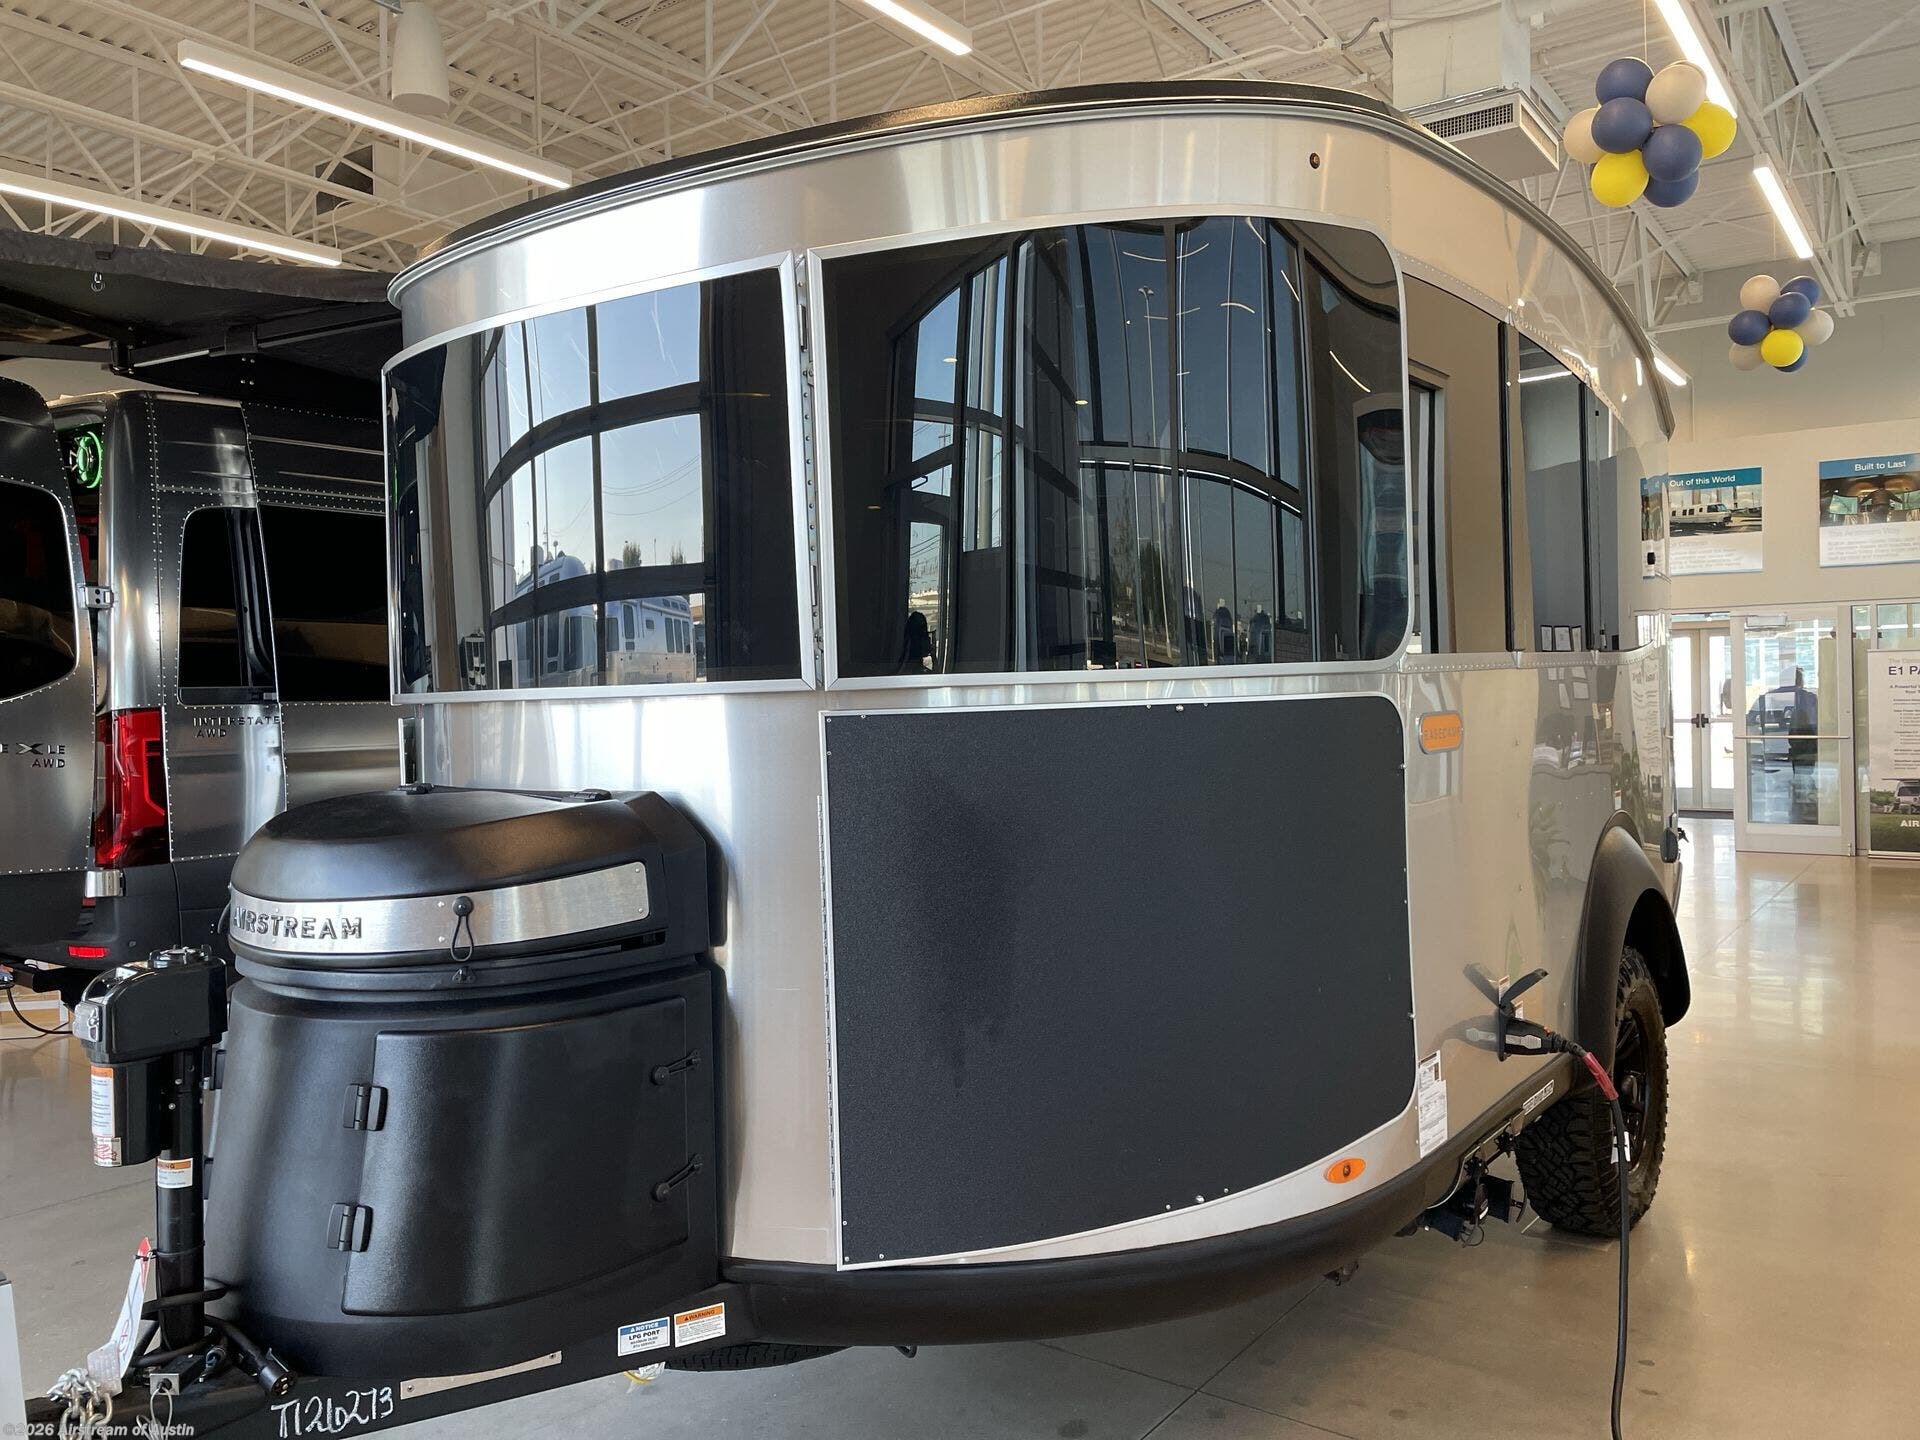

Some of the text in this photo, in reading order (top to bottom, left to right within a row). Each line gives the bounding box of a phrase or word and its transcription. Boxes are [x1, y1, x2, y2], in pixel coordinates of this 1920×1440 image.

[1854, 463, 1874, 471] Built
[1887, 460, 1906, 468] Last
[1669, 479, 1684, 487] Out
[1695, 477, 1710, 485] this
[1711, 475, 1736, 483] World
[1888, 666, 1903, 675] E1
[193, 715, 280, 727] INTERSTATE
[196, 728, 227, 738] AWD
[32, 758, 66, 768] AWD
[233, 906, 363, 940] AIRSTREAM
[689, 1309, 715, 1321] WARNING
[635, 1322, 659, 1331] NOTICE
